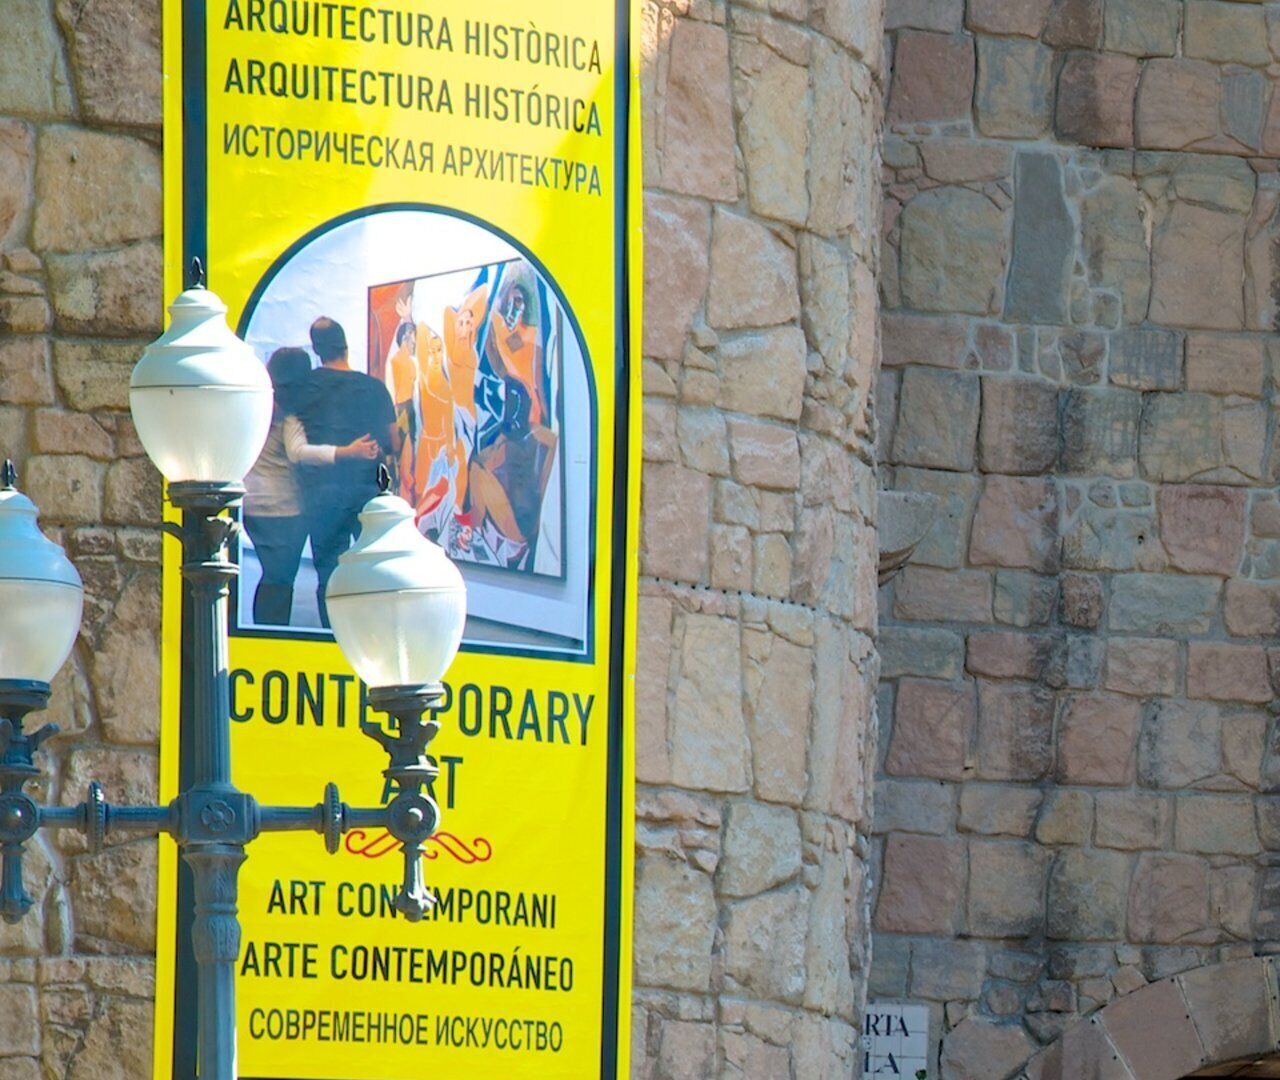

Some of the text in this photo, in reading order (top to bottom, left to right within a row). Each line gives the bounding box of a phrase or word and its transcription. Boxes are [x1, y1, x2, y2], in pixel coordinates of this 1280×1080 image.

[224, 0, 601, 74] ARQUITECTURA HISTÒRICA
[224, 58, 601, 136] ARQUITECTURA HISTÓRICA
[224, 123, 601, 196] ИСТОРИЧЕСКАЯ АРХИТЕКТУРА
[268, 880, 325, 916] ART
[240, 942, 574, 992] ARTE CONTEMPORÁNEO
[249, 1008, 563, 1052] СОВРЕМЕННОЕ ИСКУССТВО
